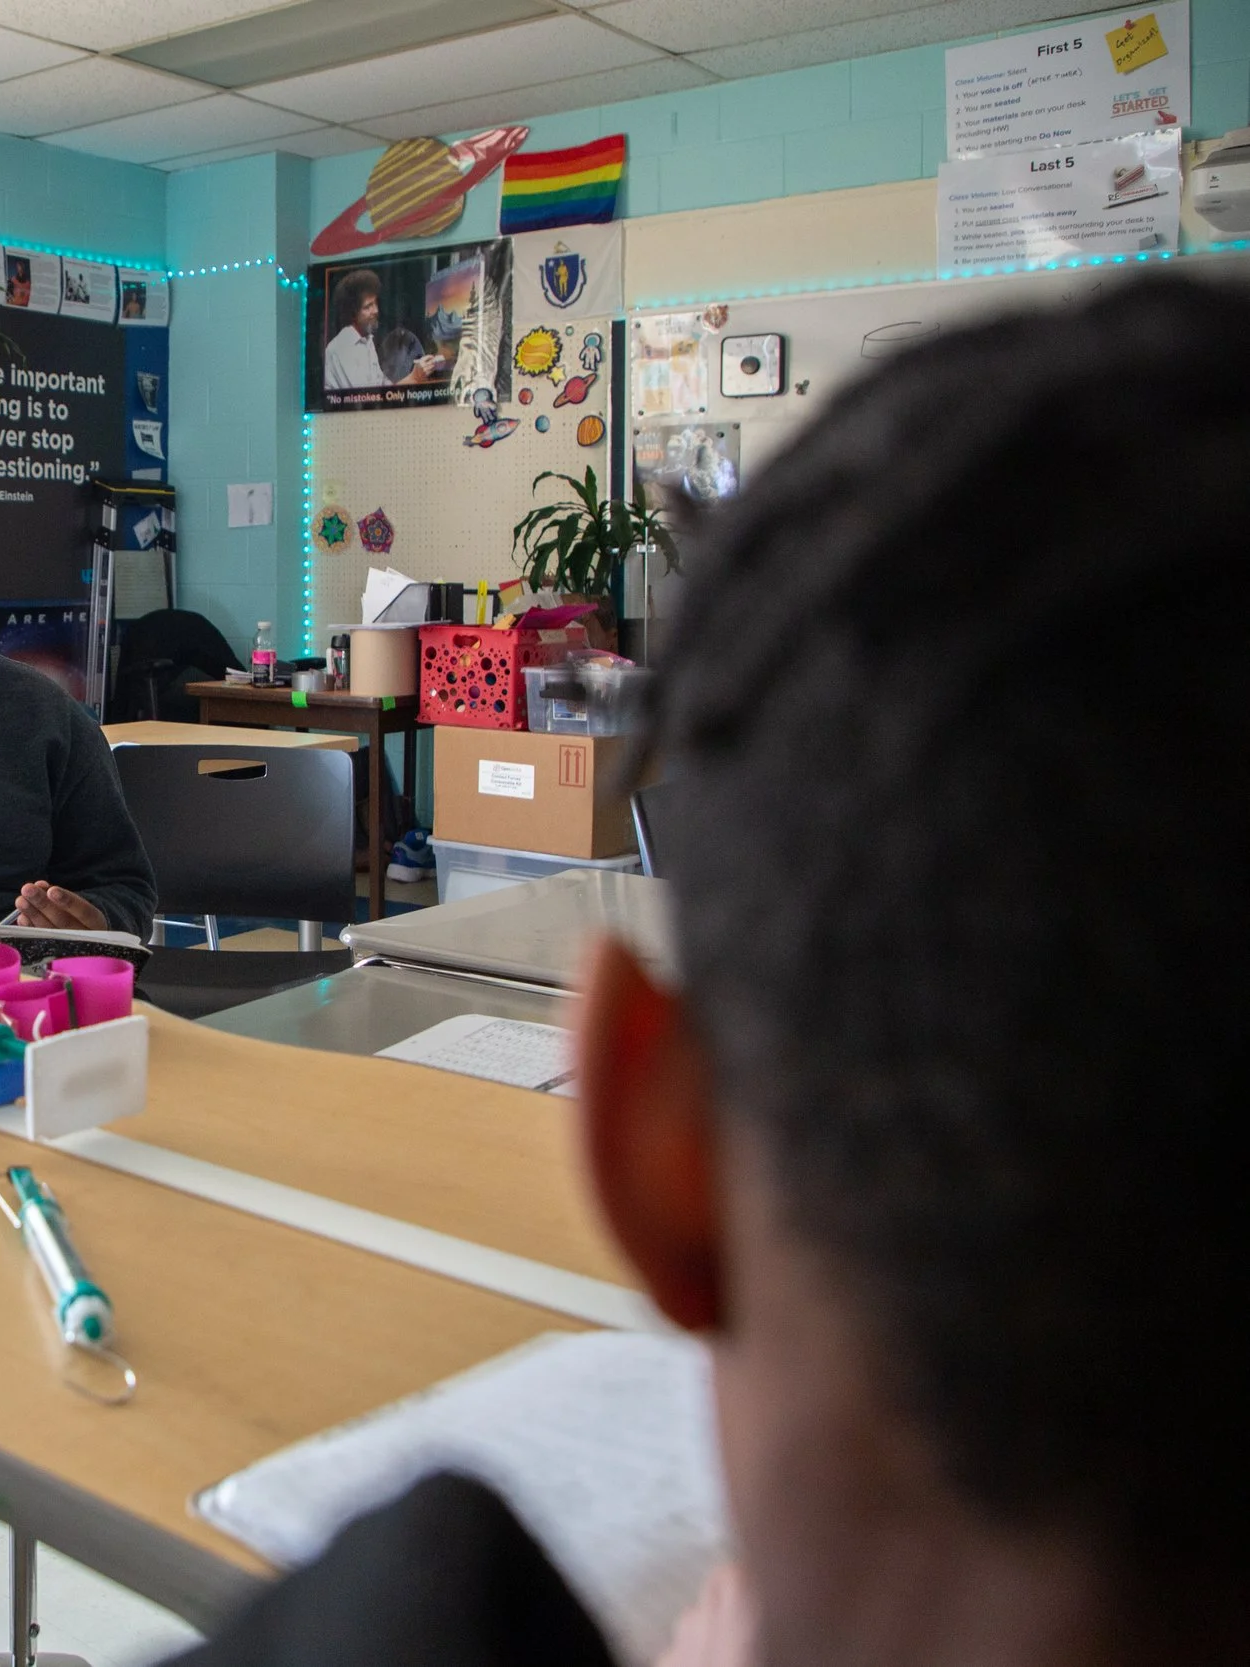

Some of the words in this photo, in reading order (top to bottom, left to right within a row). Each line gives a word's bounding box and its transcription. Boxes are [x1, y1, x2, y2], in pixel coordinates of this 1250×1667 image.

[1037, 41, 1069, 57] First
[1073, 38, 1083, 49] 5
[1007, 67, 1027, 76] Silent
[963, 90, 979, 99] Your
[980, 86, 1001, 95] voice
[1011, 82, 1023, 90] off
[1148, 87, 1168, 96] GET
[964, 105, 978, 113] You
[994, 97, 1021, 107] seated
[1112, 95, 1169, 114] STARTED
[964, 119, 980, 128] Your
[982, 112, 1019, 124] materials
[1020, 110, 1033, 118] are
[1047, 105, 1065, 114] your
[1067, 100, 1086, 109] desk
[965, 144, 979, 152] You
[994, 137, 1023, 148] starting
[1024, 134, 1037, 142] the
[1039, 132, 1051, 140] Do
[1053, 129, 1072, 138] Now
[1030, 159, 1061, 172] Last
[1066, 156, 1075, 168] 5
[1017, 182, 1073, 194] Conversational
[962, 206, 975, 214] You
[989, 202, 1014, 211] seated
[1021, 210, 1055, 220] materials
[1056, 209, 1077, 218] away
[1058, 219, 1104, 230] surrounding
[1105, 219, 1123, 228] your
[1125, 216, 1144, 225] desk
[975, 242, 994, 250] away
[1107, 228, 1127, 237] arms
[10, 363, 106, 395] important
[343, 392, 384, 403] mistakes.
[385, 390, 405, 402] Only
[406, 388, 432, 400] happy
[27, 396, 43, 418] is
[48, 399, 69, 420] to
[31, 428, 74, 454] stop
[7, 613, 46, 625] ARE
[63, 612, 87, 622] HE
